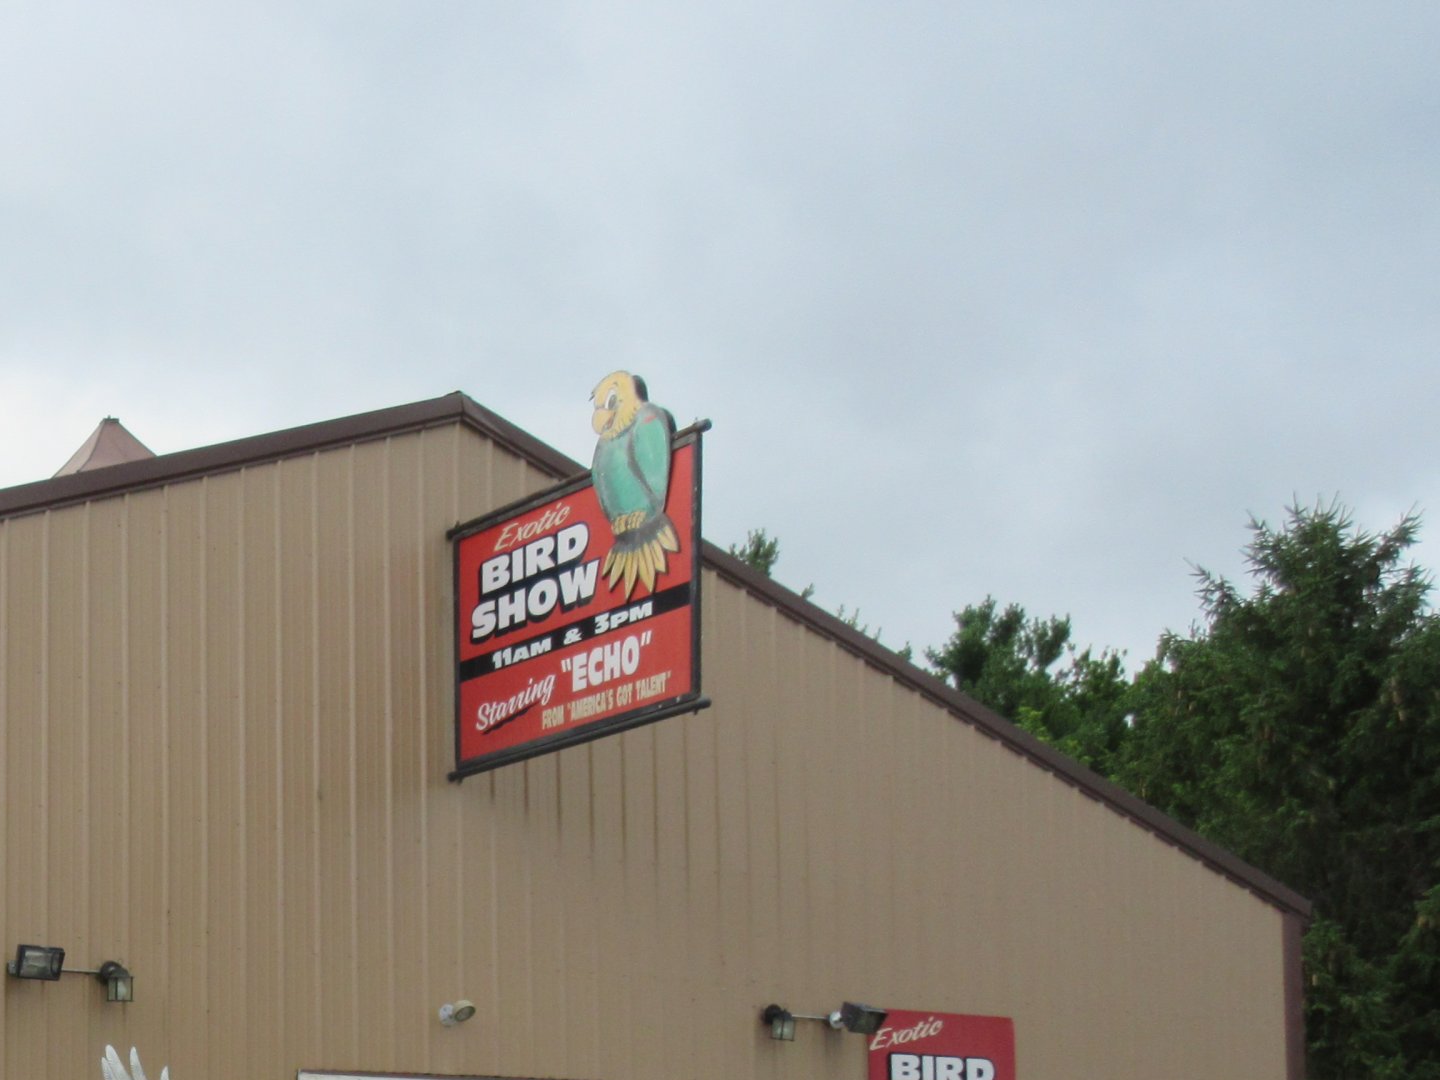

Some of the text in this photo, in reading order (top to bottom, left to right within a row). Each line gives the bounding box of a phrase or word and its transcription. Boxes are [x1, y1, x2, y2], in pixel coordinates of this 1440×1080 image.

[481, 522, 589, 595] BIRD
[494, 502, 571, 551] Exotic
[471, 559, 600, 639] SHOW
[492, 601, 653, 670] 11AM & 3PM
[475, 630, 652, 731] Starring "ECHO"
[542, 705, 565, 731] FROM
[616, 682, 634, 708] GOT
[869, 1016, 944, 1051] Exotic
